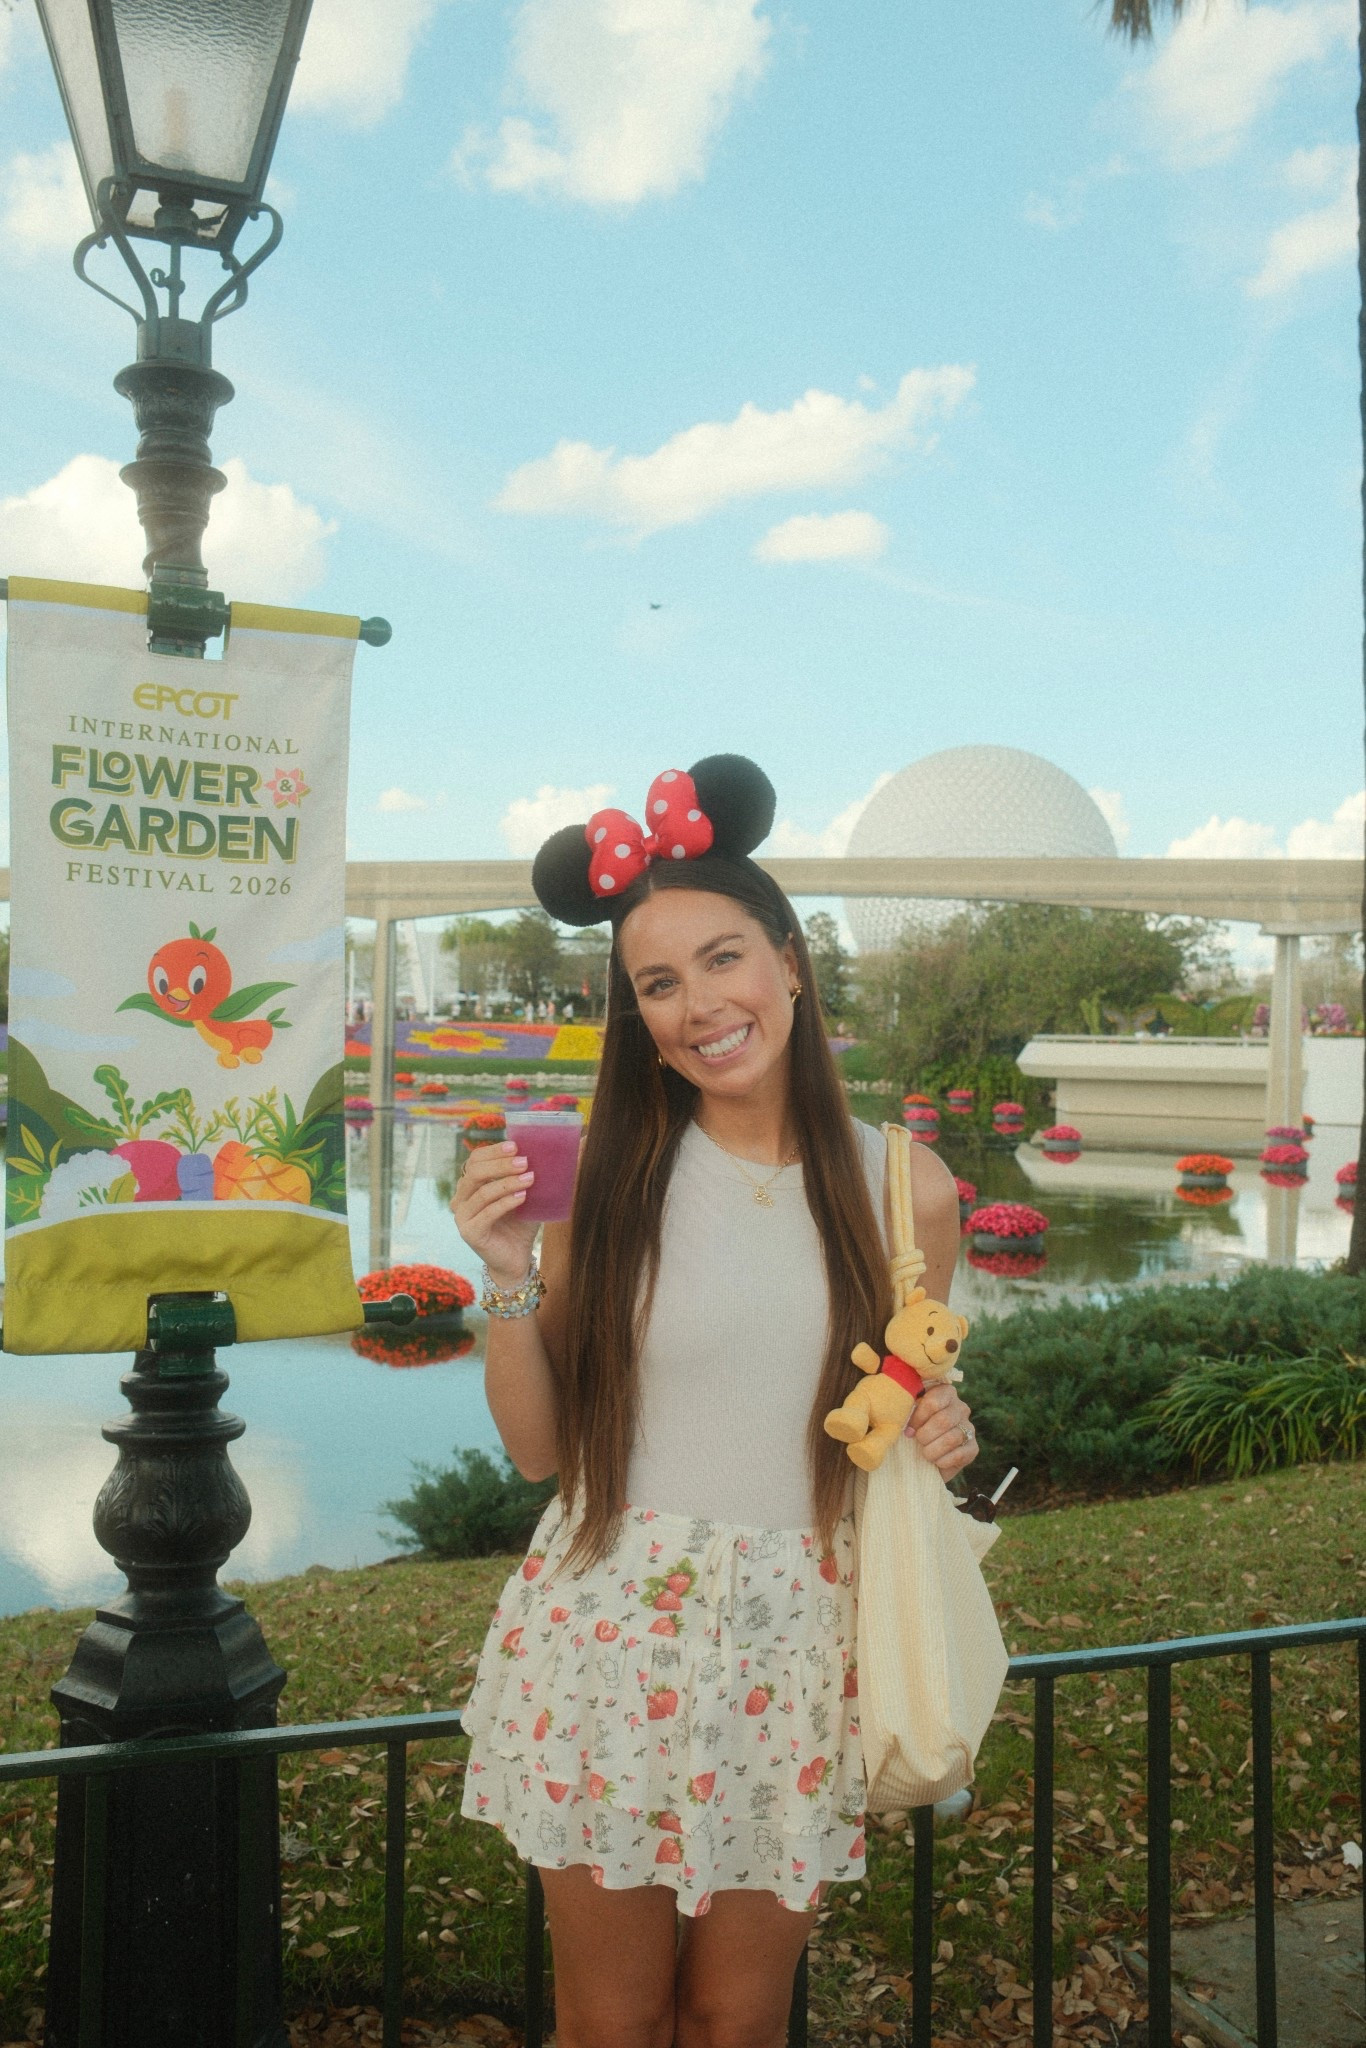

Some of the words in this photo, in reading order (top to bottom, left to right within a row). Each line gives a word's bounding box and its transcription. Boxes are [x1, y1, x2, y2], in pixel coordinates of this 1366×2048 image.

[132, 682, 239, 721] EPCOT
[68, 715, 299, 755] INTERNATIONAL
[51, 744, 264, 808] FLOWER
[279, 779, 293, 792] &
[49, 797, 299, 864] GARDEN
[66, 861, 214, 893] FESTIVAL
[230, 876, 292, 896] 2026
